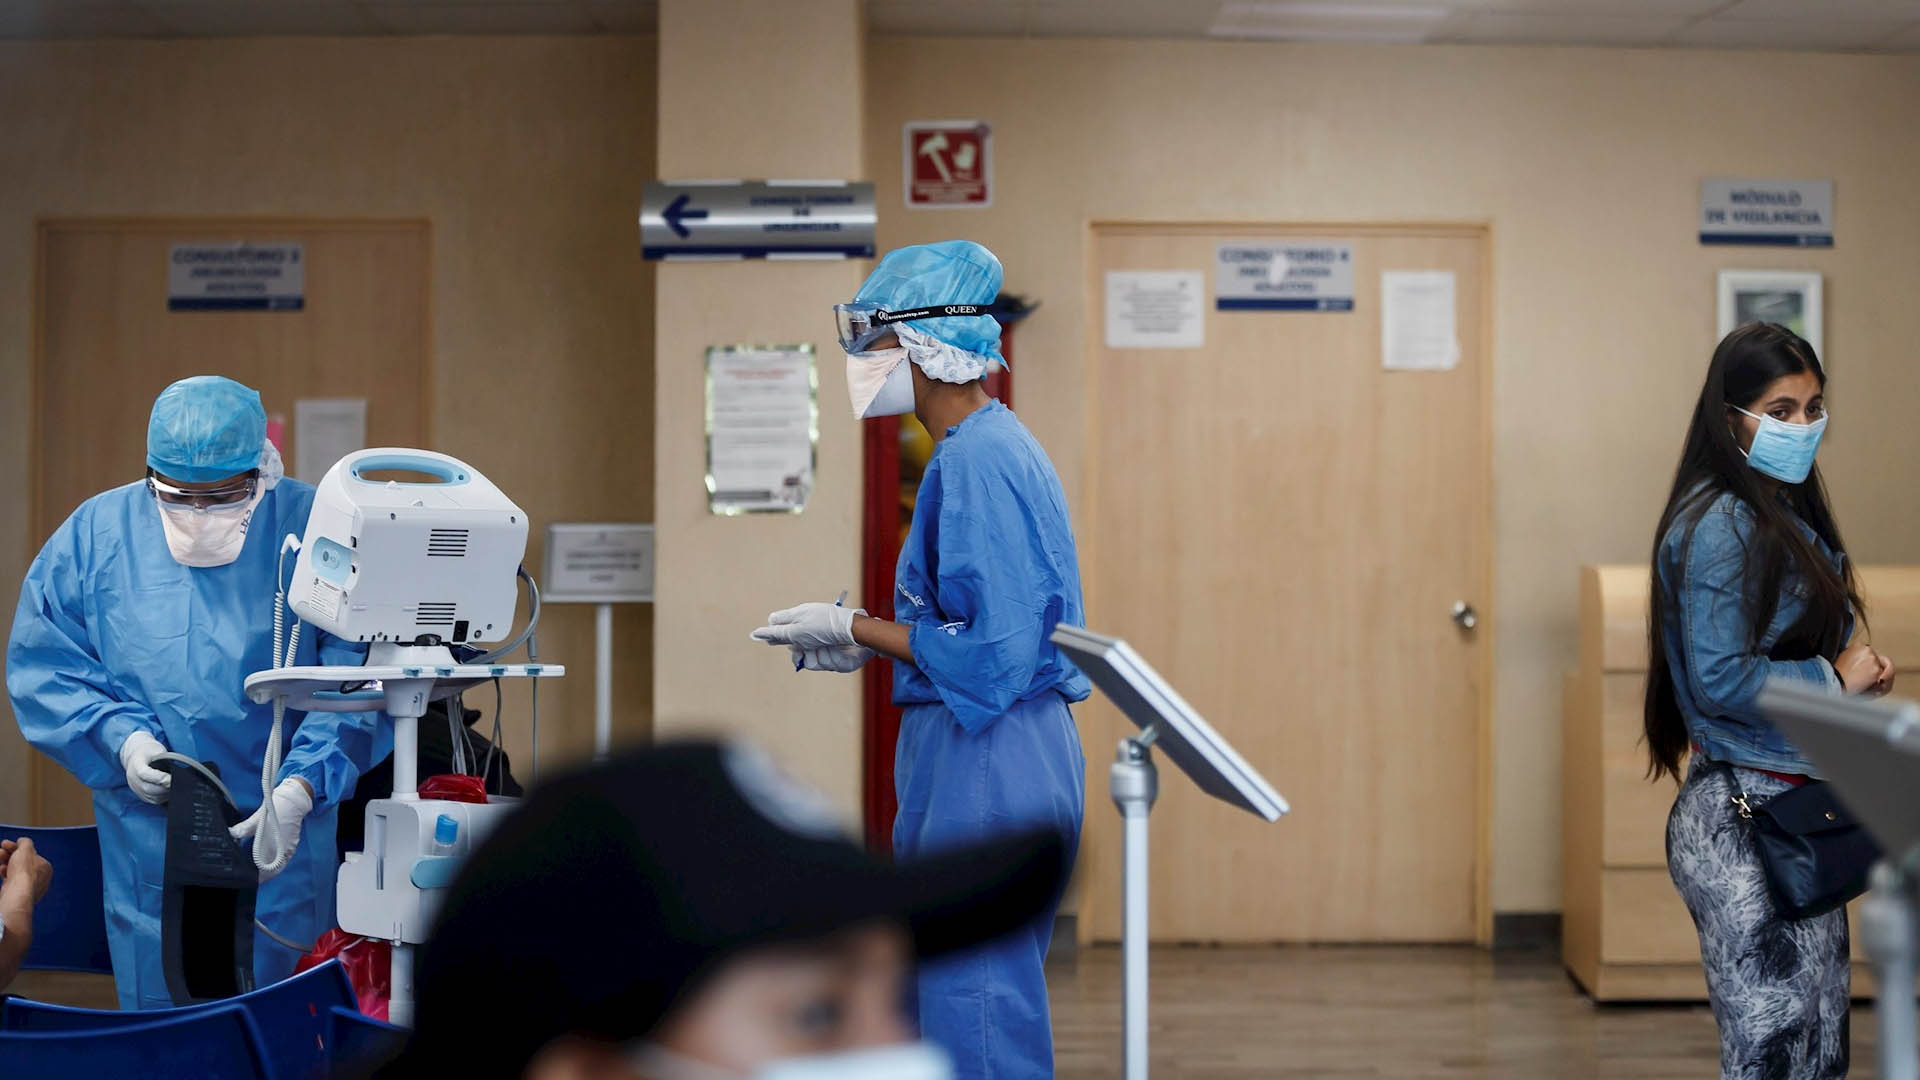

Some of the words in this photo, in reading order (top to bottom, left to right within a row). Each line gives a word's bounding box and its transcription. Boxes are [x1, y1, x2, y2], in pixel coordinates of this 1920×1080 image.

[1731, 188, 1802, 205] MÓDULO
[1706, 209, 1727, 223] DE
[1732, 210, 1821, 224] VIGILANCIA
[1220, 248, 1335, 263] CONSUTORIO
[944, 305, 978, 315] QUEEN
